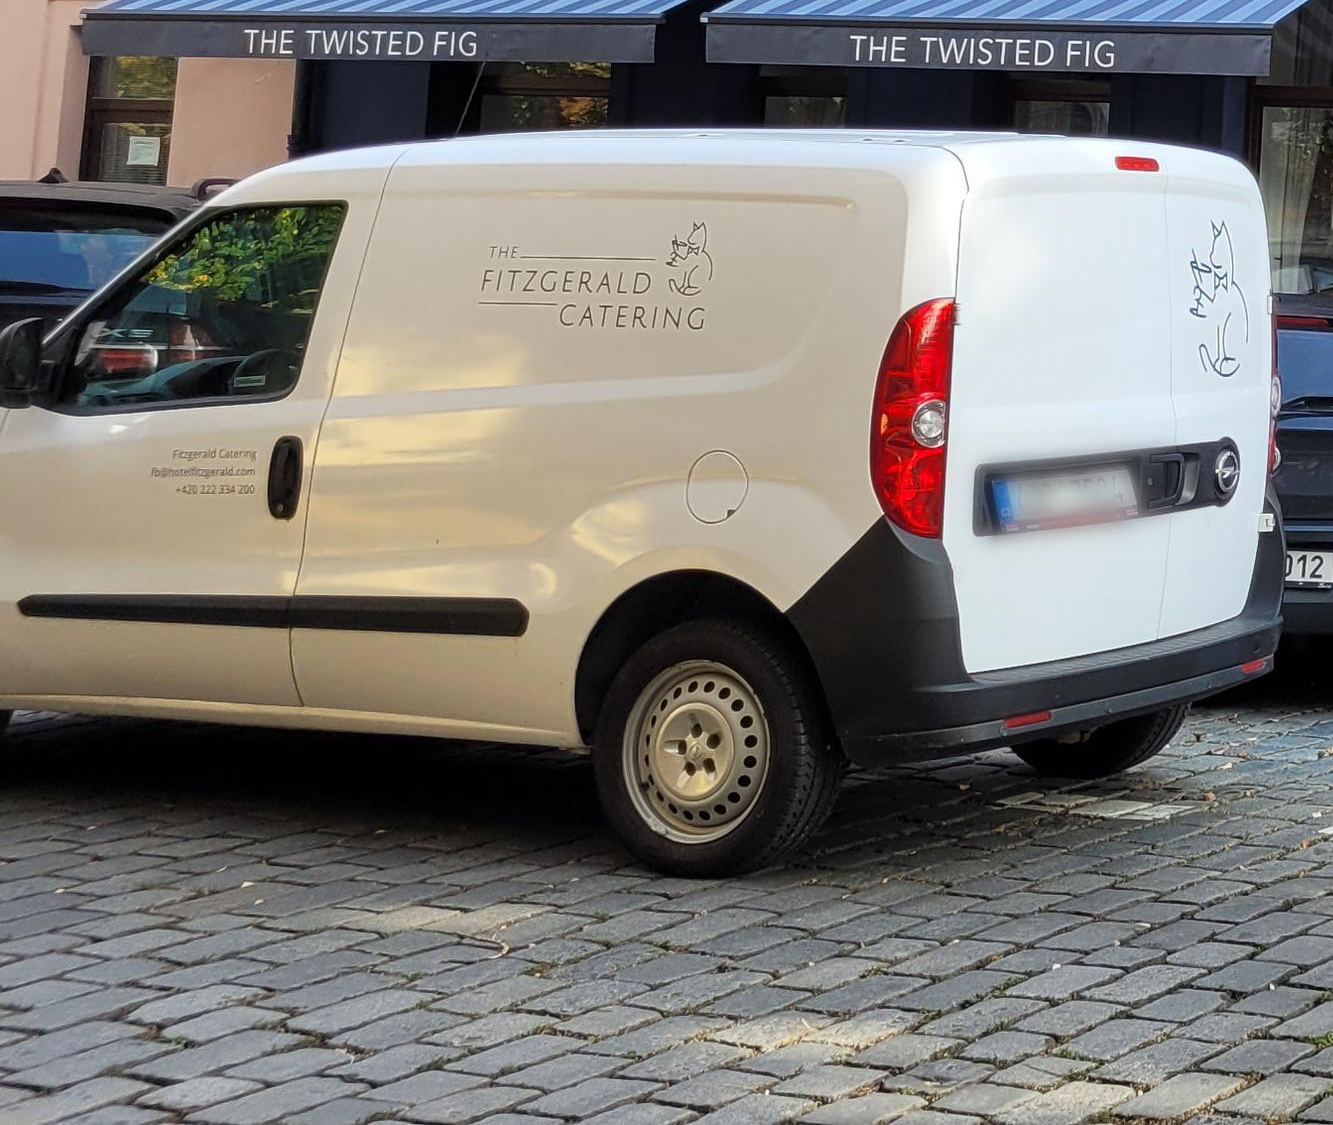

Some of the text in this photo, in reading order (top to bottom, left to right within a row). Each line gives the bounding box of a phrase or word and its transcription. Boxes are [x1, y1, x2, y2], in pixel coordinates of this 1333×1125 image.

[243, 29, 478, 58] THE TWISTED FIG
[849, 34, 1116, 69] THE TWISTED FIG
[489, 245, 520, 259] THE
[481, 269, 652, 295] FITZGERALD
[559, 303, 706, 331] CATERING
[172, 449, 257, 461] Fitzgerald Catering
